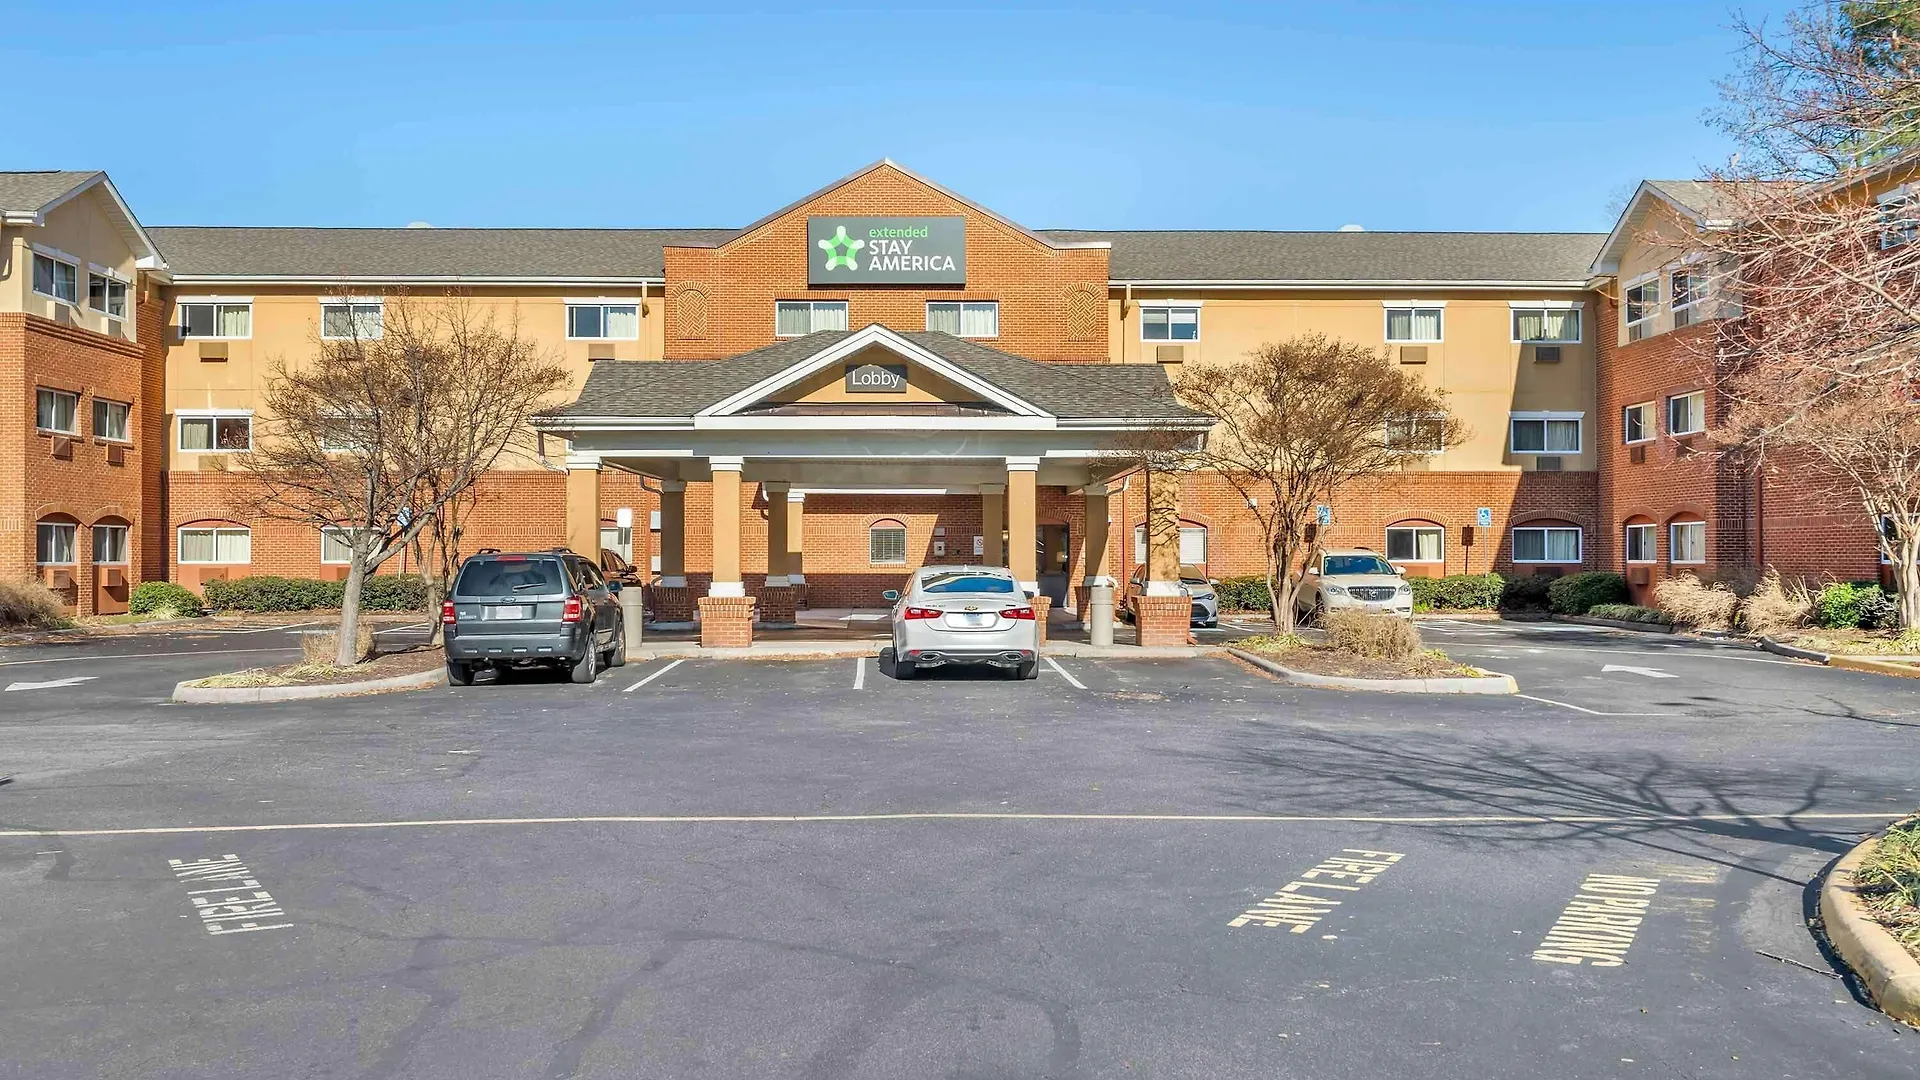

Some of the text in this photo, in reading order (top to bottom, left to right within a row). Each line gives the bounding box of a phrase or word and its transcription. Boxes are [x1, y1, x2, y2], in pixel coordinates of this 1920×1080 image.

[868, 226, 928, 238] extended
[868, 240, 913, 255] STAY
[868, 256, 956, 271] AMERICA
[852, 371, 900, 388] Lobby
[1226, 848, 1406, 934] FIRE LANE
[191, 891, 294, 935] FIRE
